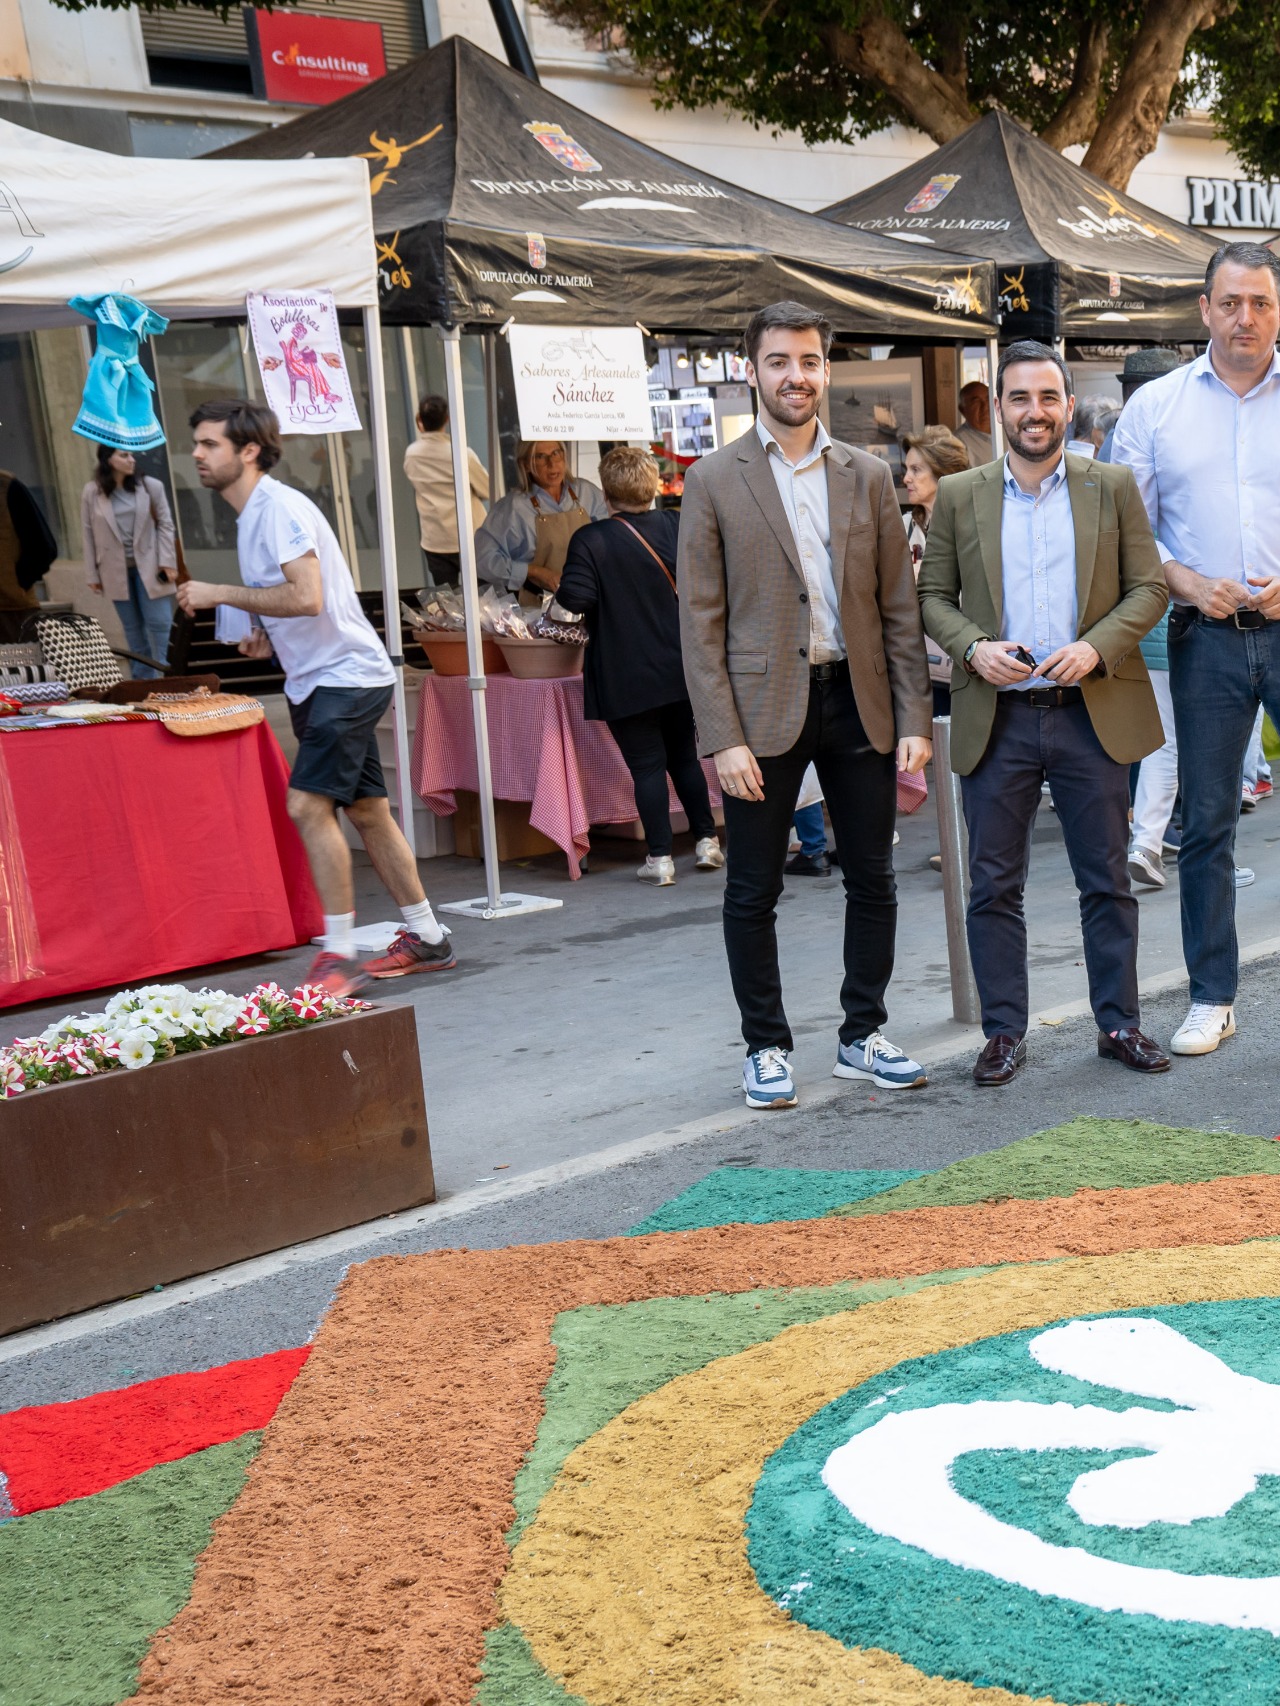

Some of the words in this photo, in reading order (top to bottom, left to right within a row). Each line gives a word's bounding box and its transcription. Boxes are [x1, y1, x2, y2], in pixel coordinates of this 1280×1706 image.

[272, 43, 369, 76] Consulting
[471, 176, 611, 195] DIPUTACIÓN
[608, 179, 641, 193] DE
[643, 181, 729, 199] ALMERÍA
[906, 217, 933, 229] DE
[932, 218, 1011, 231] ALMERÍA
[480, 270, 537, 285] DIPUTACIÓN
[540, 274, 553, 285] DE
[554, 273, 593, 288] ALMERÍA
[263, 295, 317, 307] Asociación
[998, 294, 1030, 312] ores
[1079, 298, 1114, 309] DIPUTACIÓN
[1114, 301, 1122, 309] DE
[1123, 300, 1145, 310] ALMERÍA
[270, 309, 320, 334] Bolilleras
[520, 361, 570, 379] Sabores
[571, 363, 640, 381] Artesanales
[552, 381, 615, 406] Sánchez
